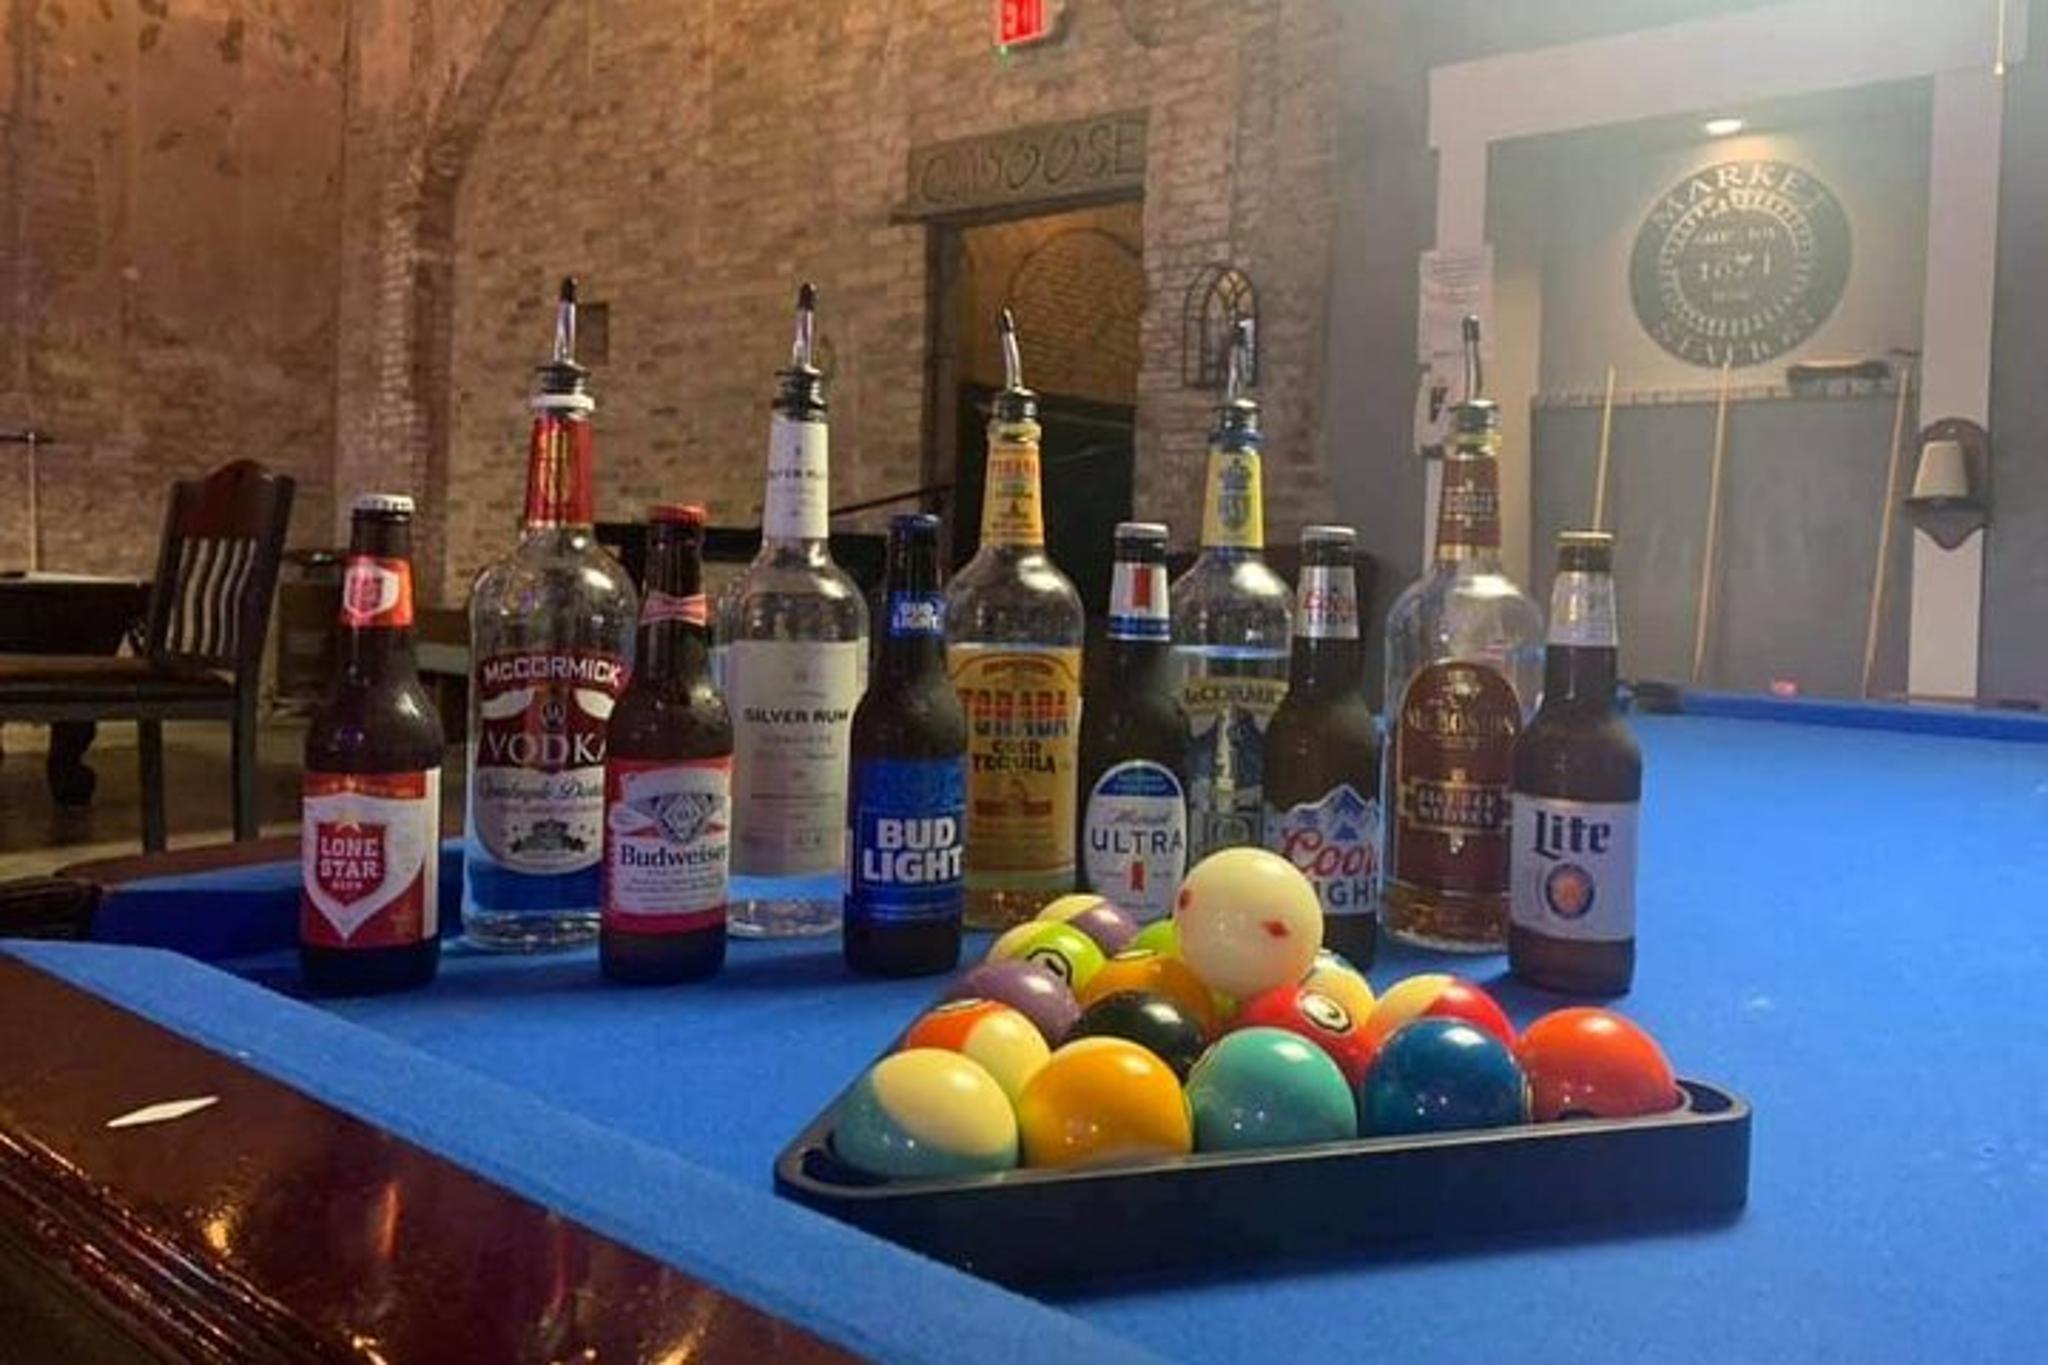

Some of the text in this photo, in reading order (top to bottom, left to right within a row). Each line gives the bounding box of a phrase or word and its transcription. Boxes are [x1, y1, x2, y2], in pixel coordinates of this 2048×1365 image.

[743, 708, 849, 724] SILVER RUM
[973, 753, 1056, 775] TEQUILA
[877, 816, 957, 849] BUD
[1091, 827, 1184, 854] ULTRA
[1533, 811, 1611, 861] Lite
[320, 837, 379, 857] LONE
[320, 858, 380, 879] STAR
[863, 844, 965, 883] LIGHT
